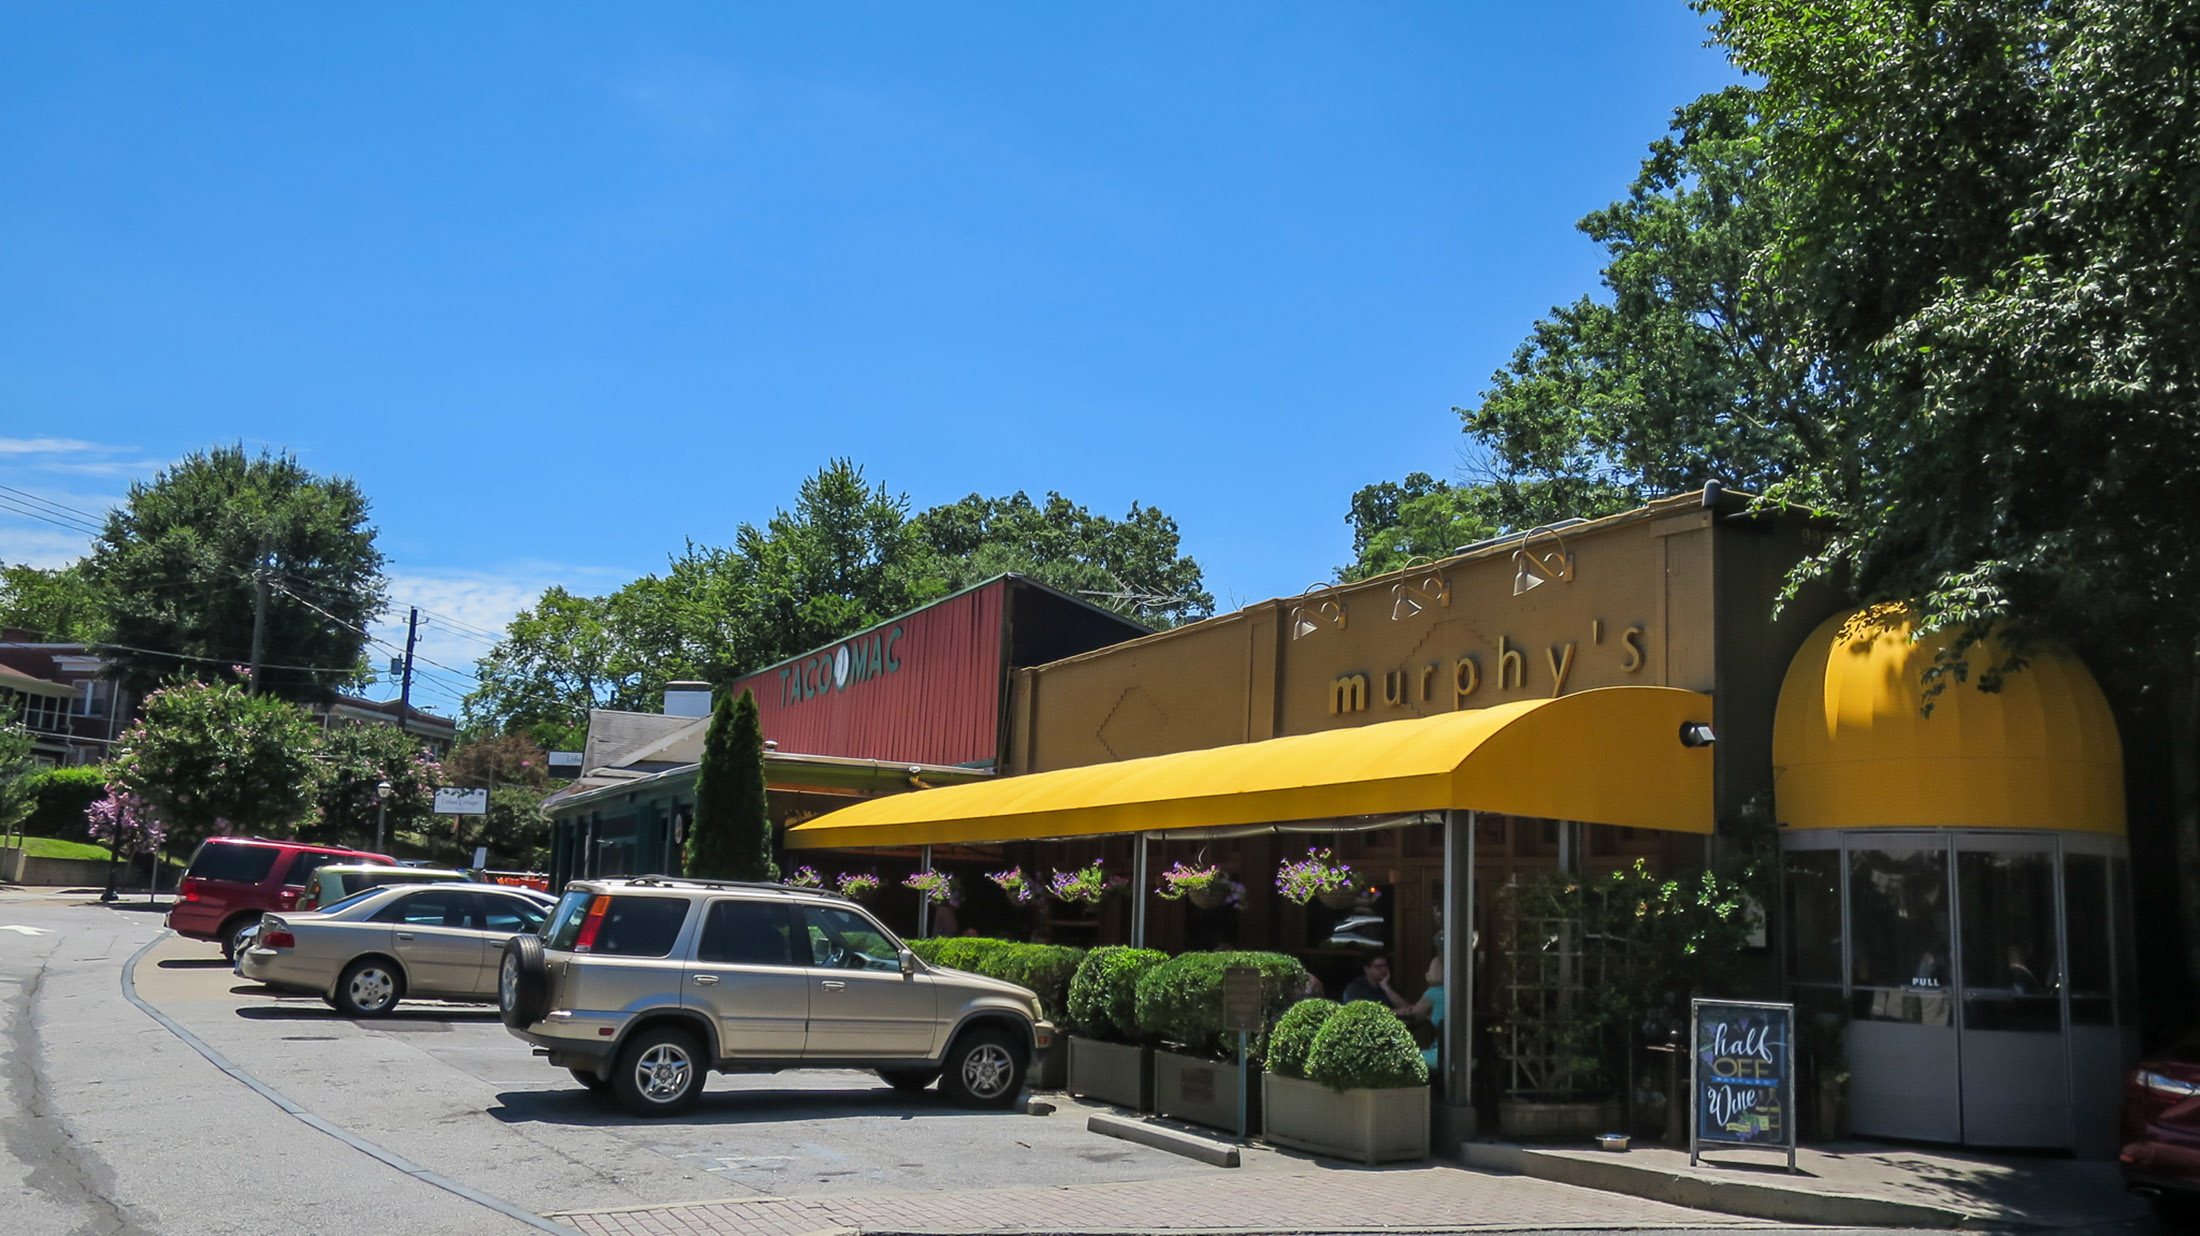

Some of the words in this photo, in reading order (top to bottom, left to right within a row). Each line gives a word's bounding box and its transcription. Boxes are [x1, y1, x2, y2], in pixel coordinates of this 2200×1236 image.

[779, 653, 833, 709] TACO
[850, 626, 903, 687] MAC
[1329, 619, 1645, 714] murphy's
[1912, 977, 1940, 987] PULL
[1714, 1022, 1787, 1064] half
[1712, 1056, 1772, 1079] OFF
[1707, 1084, 1758, 1127] Wine
